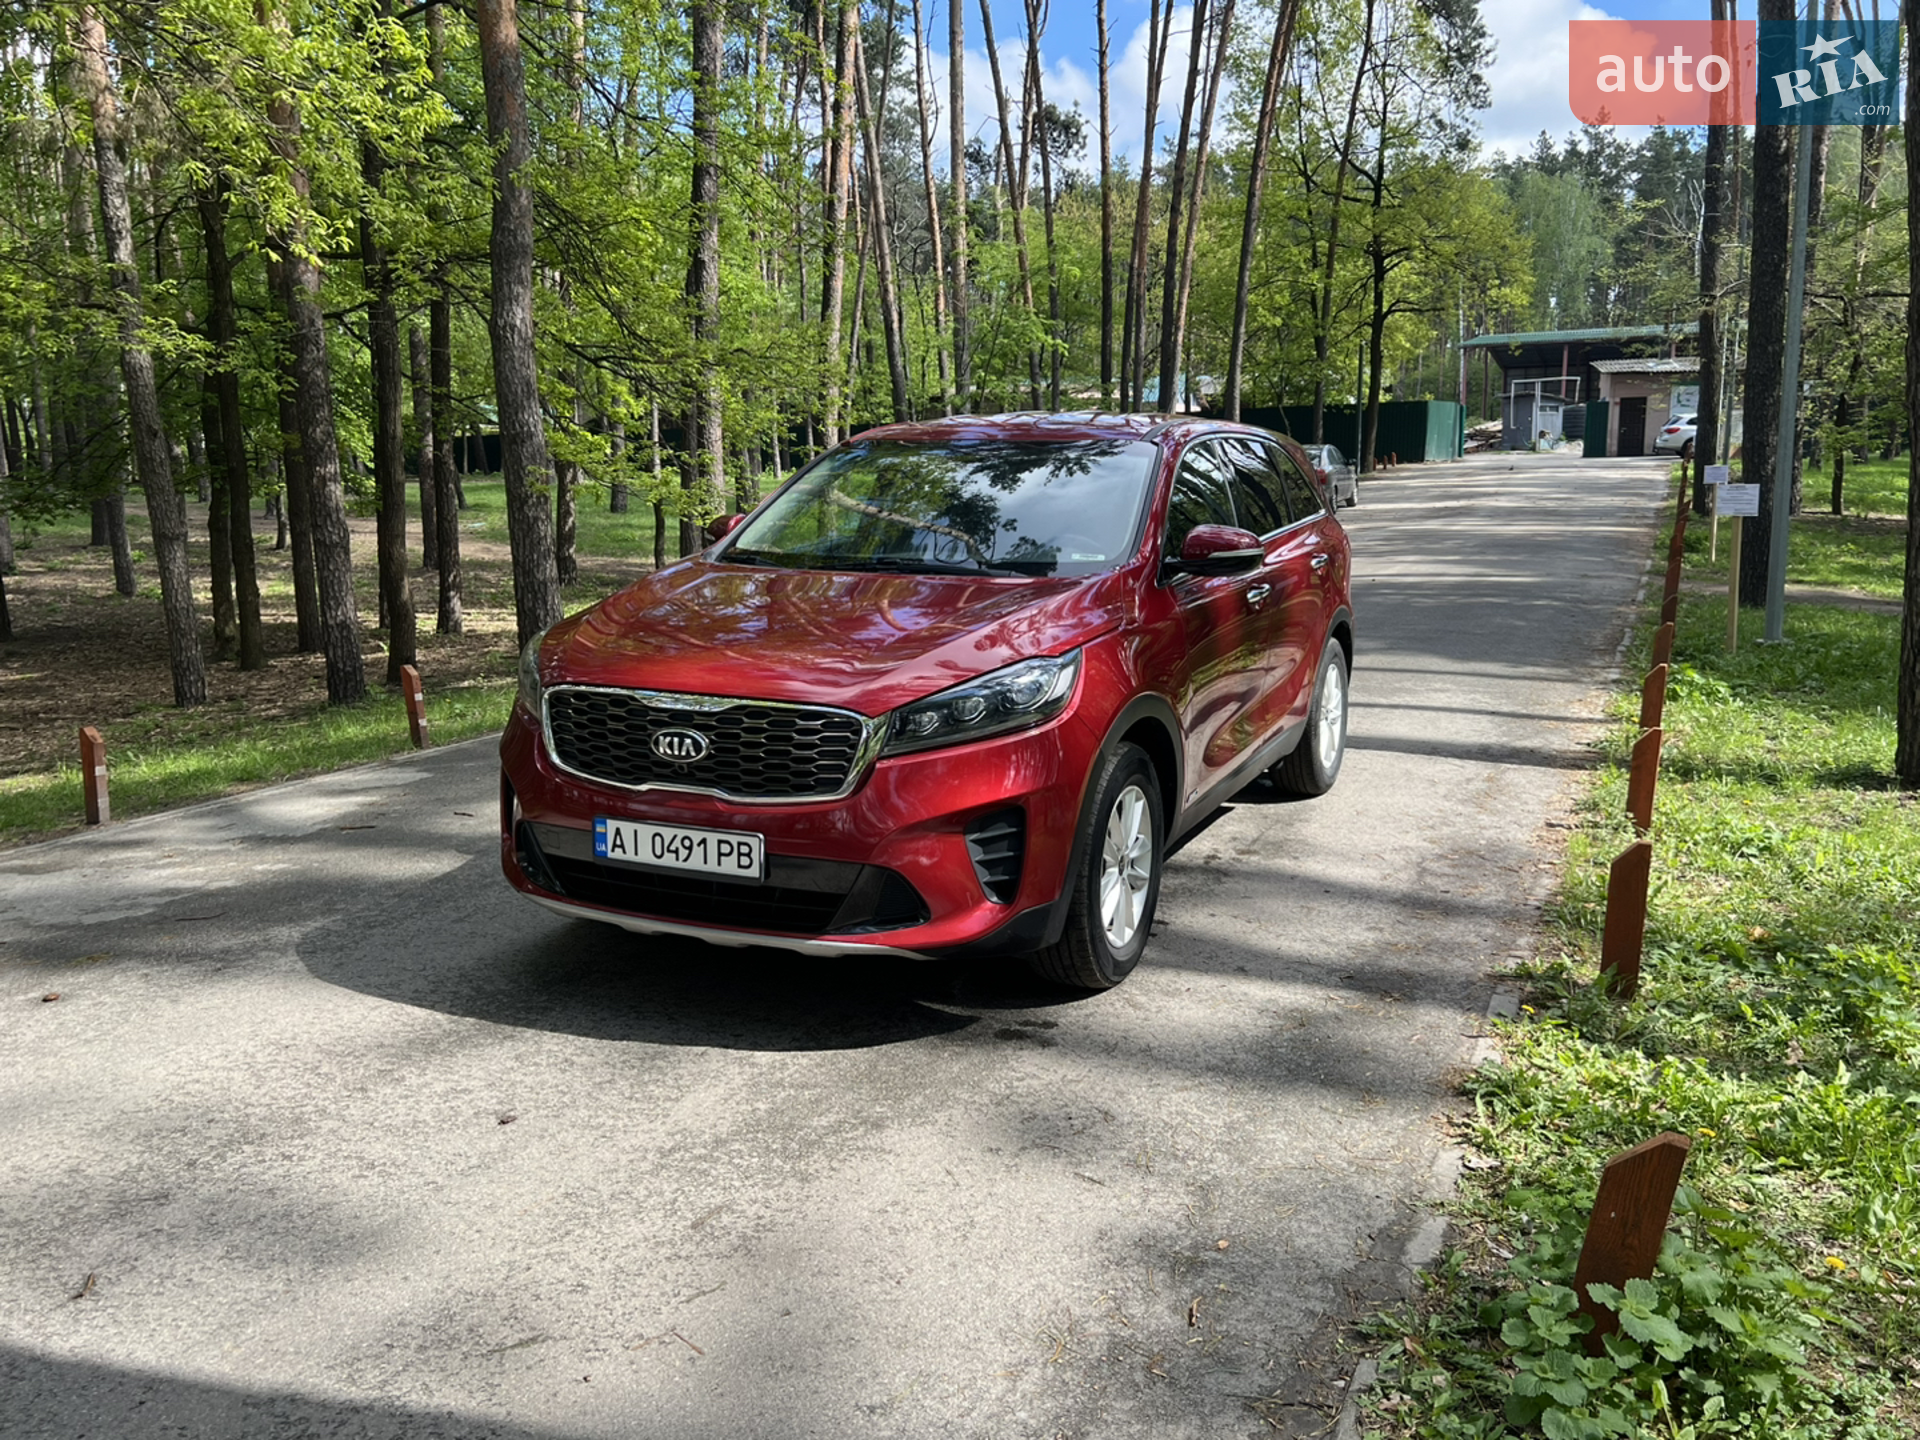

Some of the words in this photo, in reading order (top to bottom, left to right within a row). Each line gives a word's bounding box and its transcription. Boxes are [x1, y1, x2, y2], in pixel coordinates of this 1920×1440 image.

[658, 735, 697, 757] KIA
[596, 842, 607, 852] UA
[610, 826, 639, 857] AI
[651, 832, 708, 865] 0491
[717, 839, 754, 870] PB
